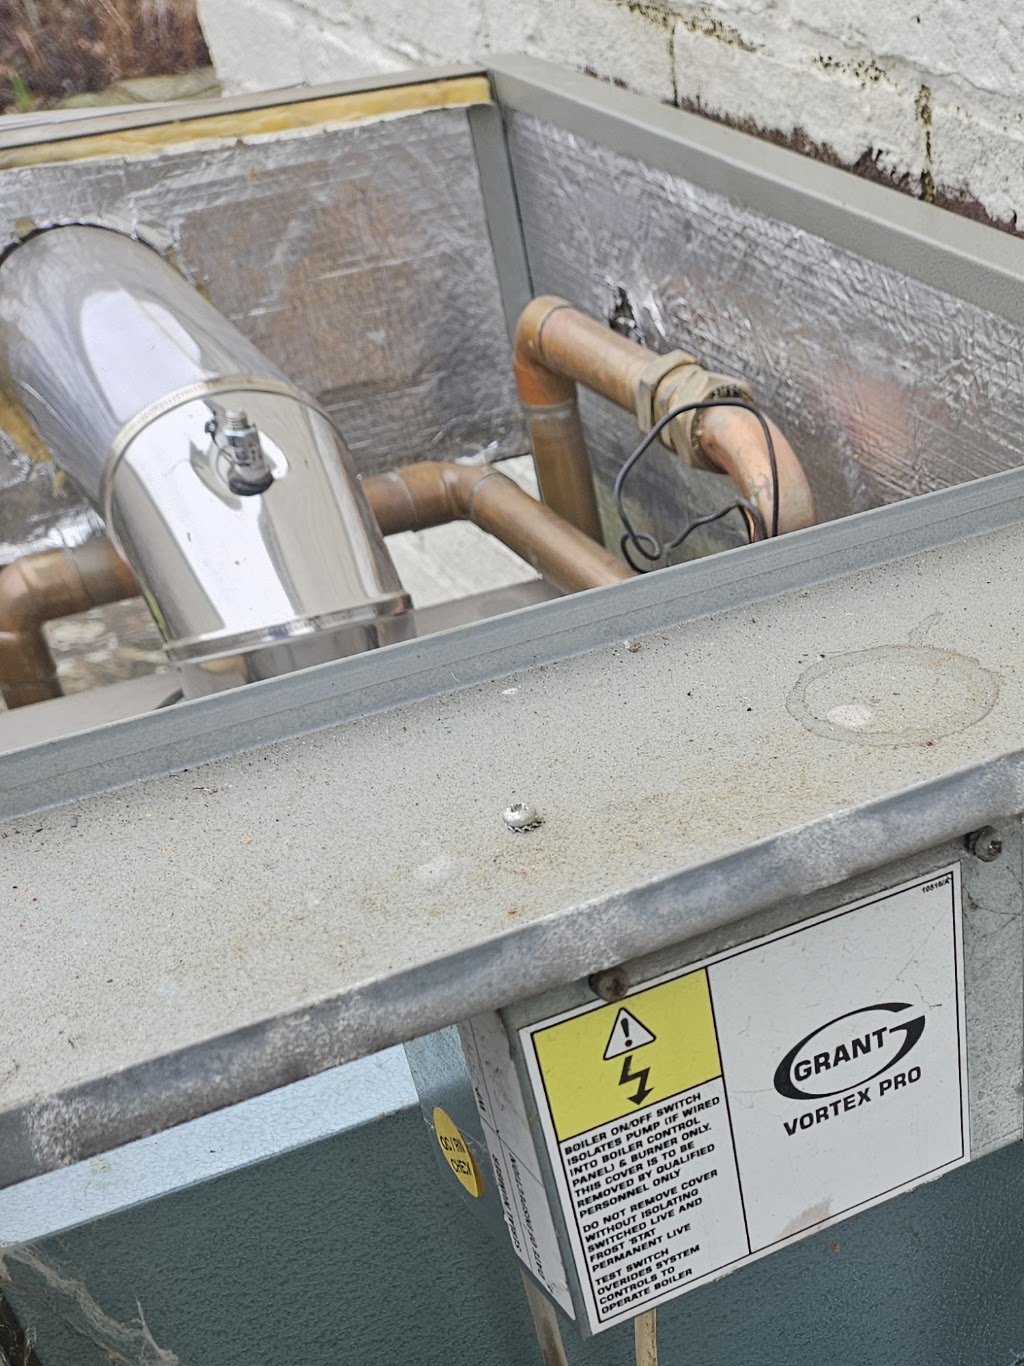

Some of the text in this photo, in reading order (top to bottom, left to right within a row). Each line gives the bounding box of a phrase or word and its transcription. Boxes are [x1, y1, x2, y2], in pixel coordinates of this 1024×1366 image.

[794, 1026, 887, 1082] GRANT
[565, 1092, 701, 1155] BOILER ON/OFF SWITCH
[783, 1066, 921, 1137] VORTEX PRO
[567, 1096, 720, 1166] ISOLATES PUMP (IF WIRED
[570, 1117, 700, 1177] INTO BOILER CONTROL
[572, 1122, 712, 1187] PANEL) & BURNER ONLY.
[574, 1141, 695, 1198] THIS COVER IS TO BE
[577, 1143, 715, 1208] REMOVED BY QUALIFIED
[580, 1168, 681, 1218] PERSONNEL ONLY
[491, 1153, 522, 1253] SERIAL NUMBER
[508, 1152, 545, 1281] DATE OF INSPECTION
[582, 1169, 718, 1233] DO NOT REMOVE COVER
[585, 1188, 699, 1243] WITHOUT ISOLATING
[588, 1197, 703, 1253] SWITCHED LIVE AND
[590, 1241, 625, 1263] FROST
[592, 1222, 691, 1272] PERMANENT LIVE
[595, 1247, 669, 1285] TEST SWITCH
[597, 1244, 700, 1295] OVERIDES SYSTEM
[600, 1265, 675, 1304] CONTROLS TO
[601, 1268, 693, 1314] OPERATE BOILER
